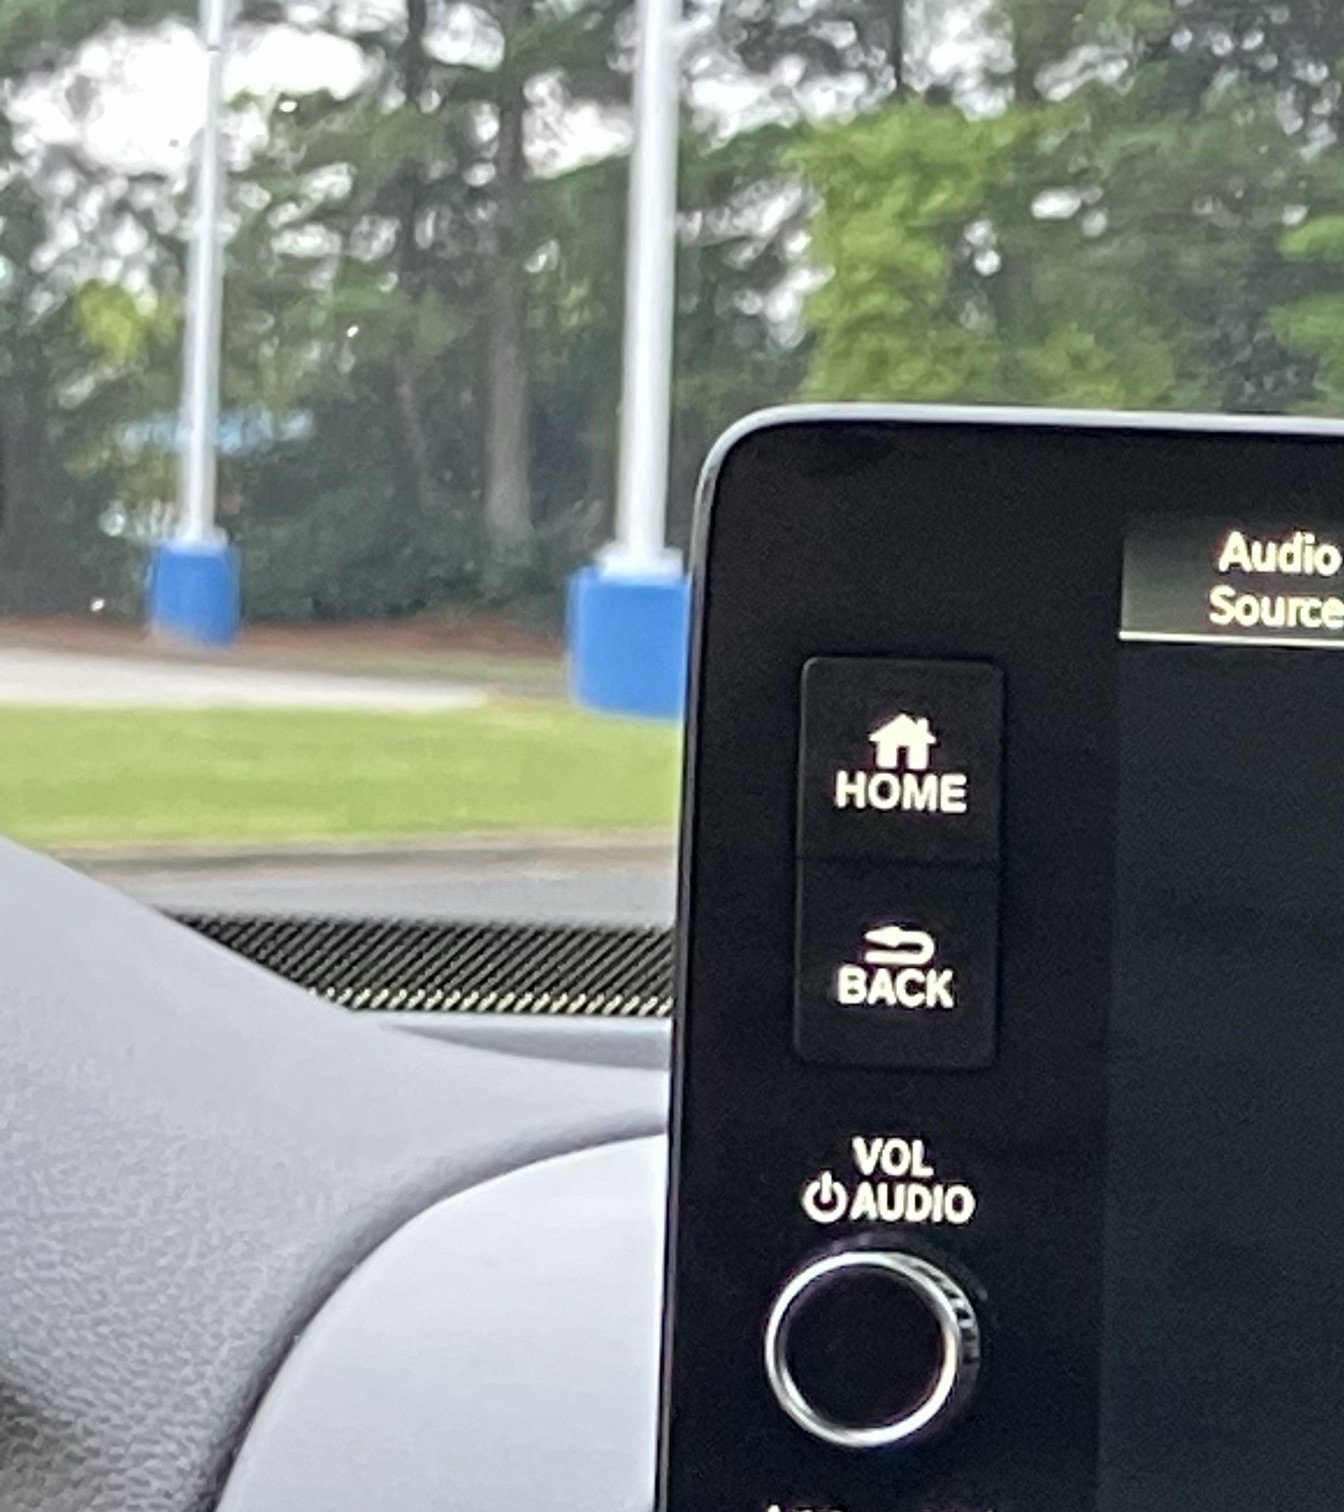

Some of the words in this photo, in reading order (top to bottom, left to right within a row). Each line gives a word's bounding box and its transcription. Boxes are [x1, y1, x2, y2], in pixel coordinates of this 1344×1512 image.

[1218, 530, 1343, 577] Audio
[835, 771, 968, 815] HOME
[837, 965, 955, 1009] BACK
[852, 1137, 934, 1177] VOL
[848, 1183, 976, 1225] AUDIO
